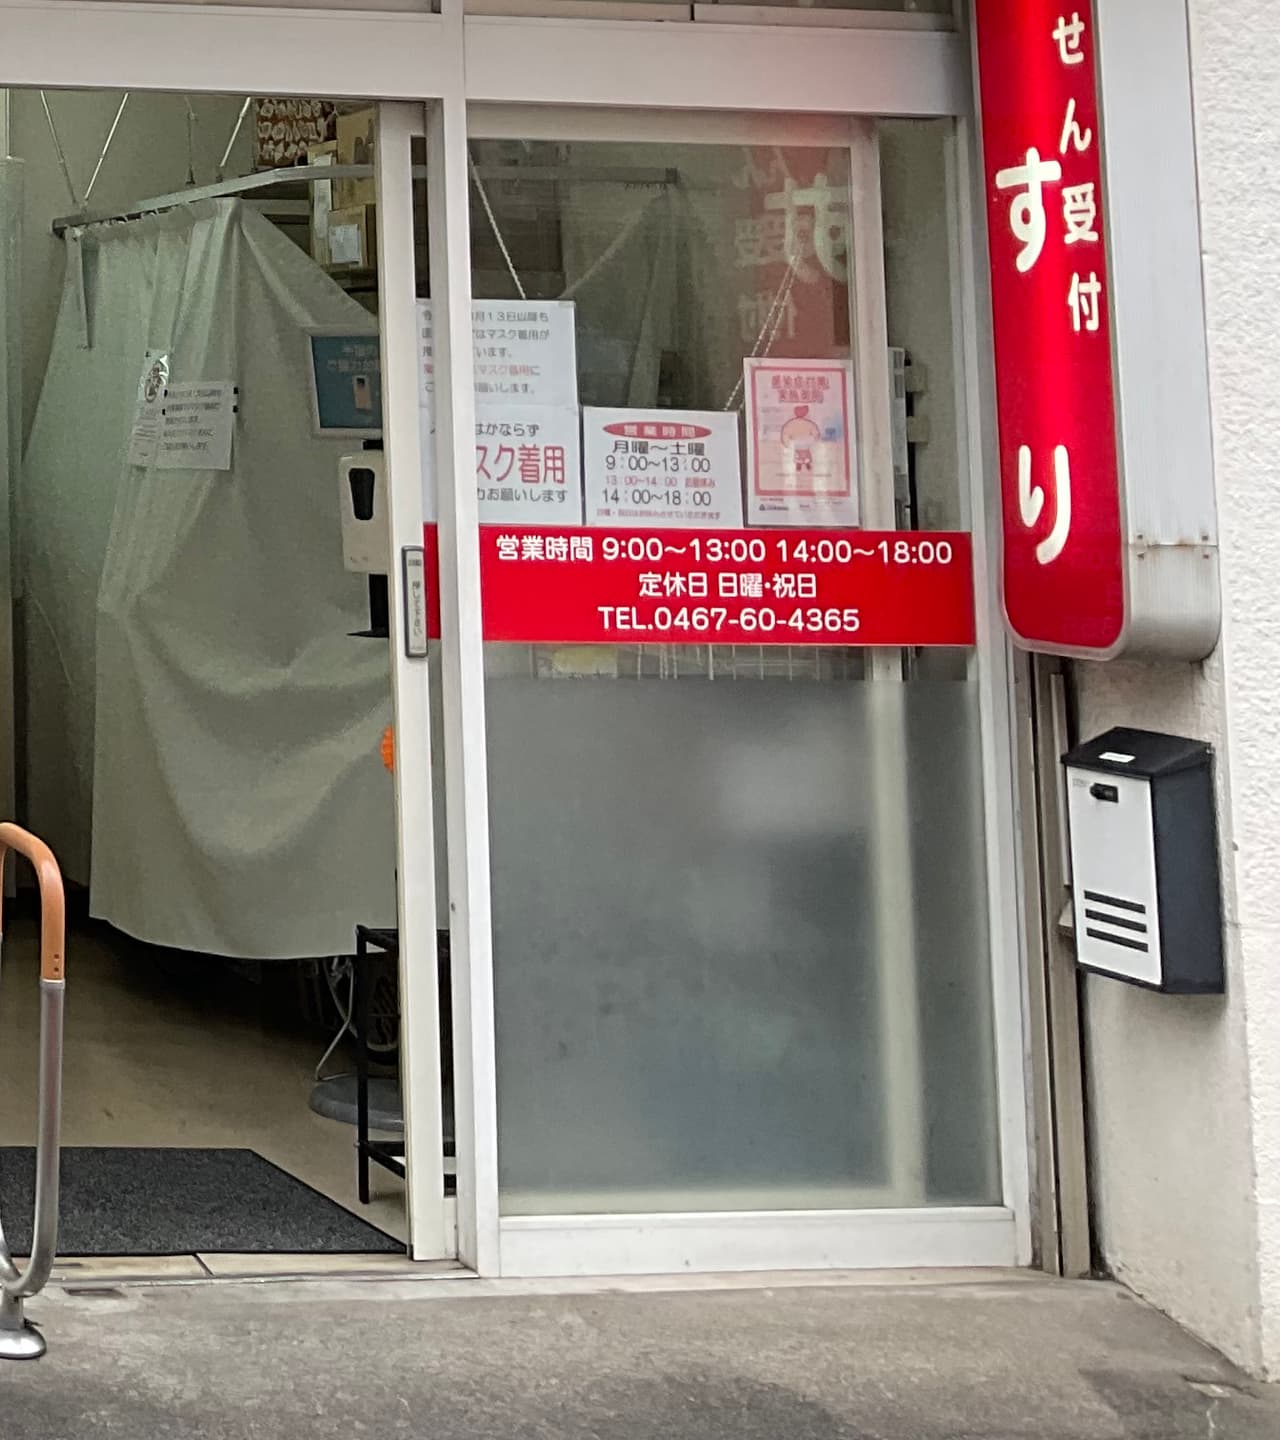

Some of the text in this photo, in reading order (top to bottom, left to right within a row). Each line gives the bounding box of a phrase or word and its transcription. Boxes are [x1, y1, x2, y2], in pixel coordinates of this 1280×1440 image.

[495, 534, 593, 563] 営業時間
[638, 572, 817, 599] 定休日 日曜・祝日
[597, 605, 861, 632] TEL.0467-60-4365
